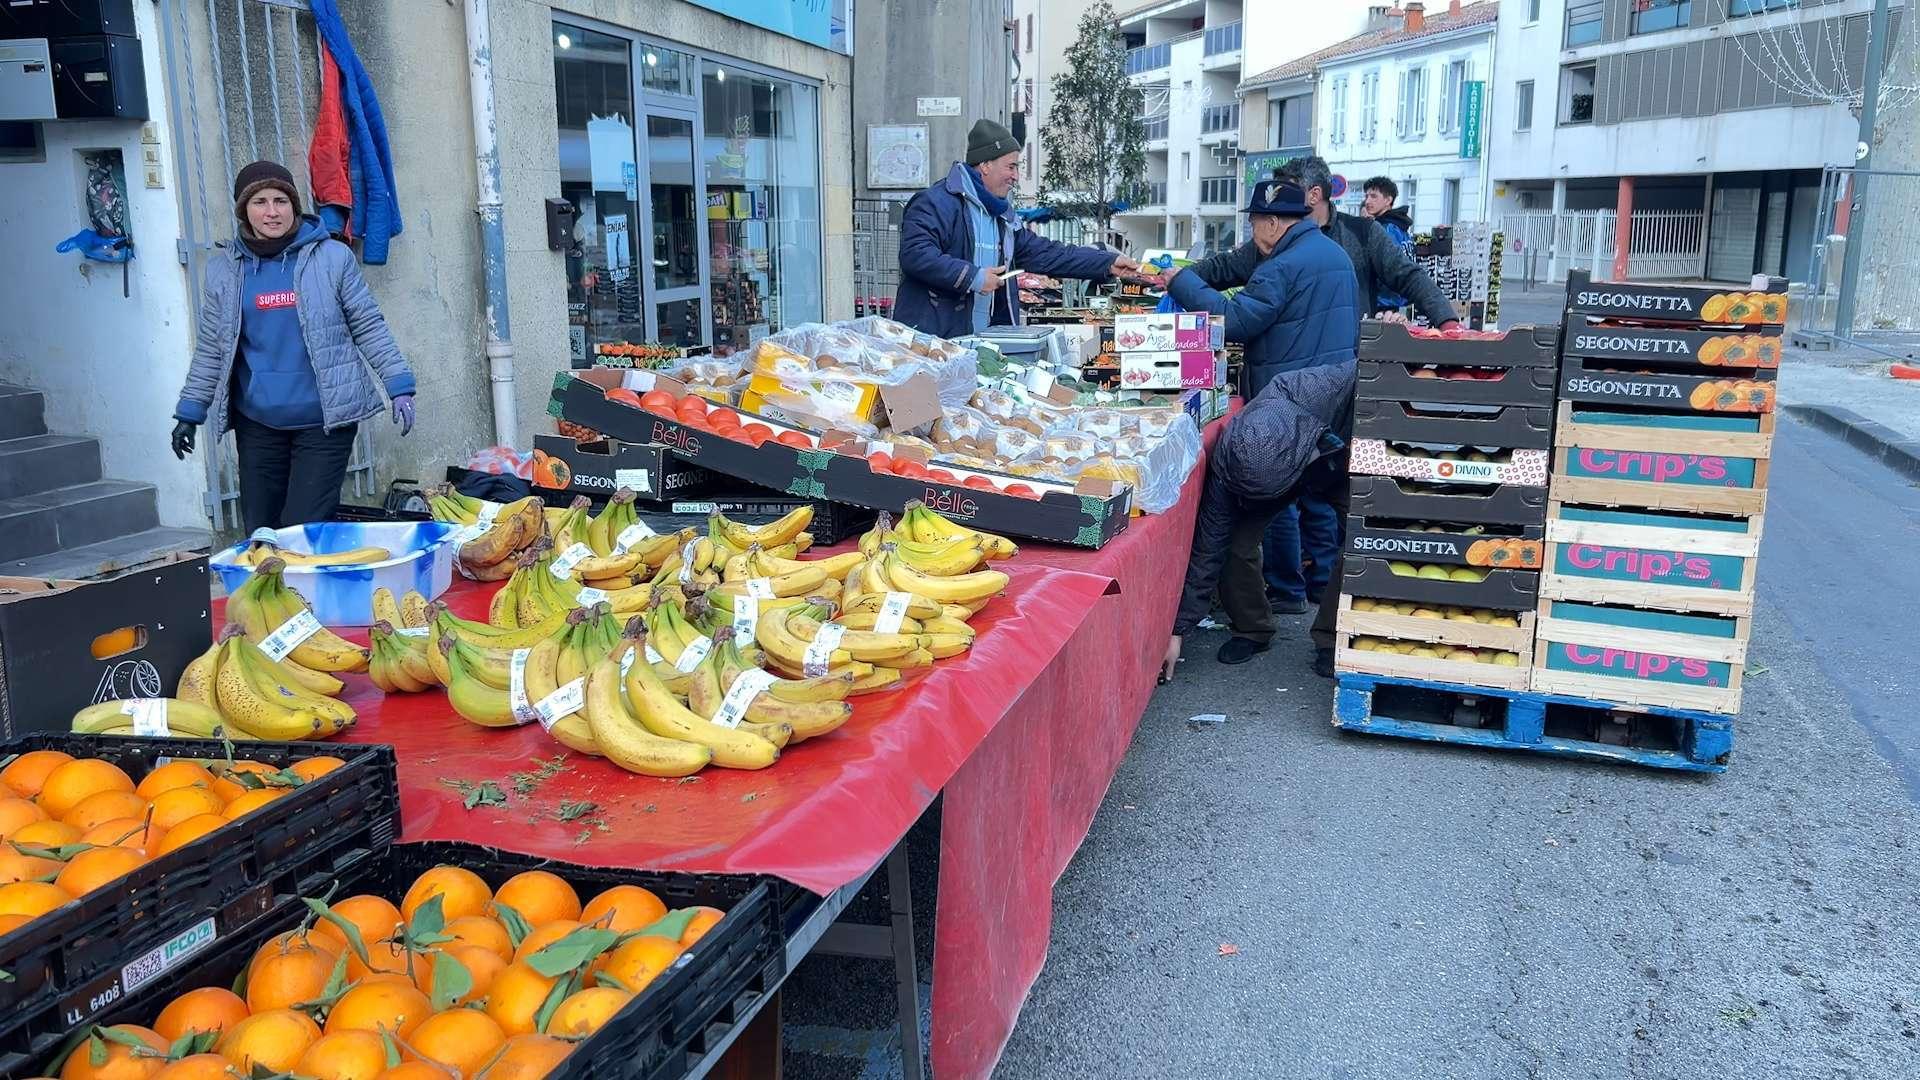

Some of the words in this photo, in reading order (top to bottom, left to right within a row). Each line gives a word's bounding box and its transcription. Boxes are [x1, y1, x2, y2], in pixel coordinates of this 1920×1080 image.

[1467, 82, 1478, 157] LABORATOIRE
[1577, 291, 1692, 311] SEGONETTA
[1147, 333, 1166, 345] Ajos
[1575, 335, 1690, 354] SEGONETTA
[1152, 370, 1173, 383] Ajos
[1567, 378, 1682, 398] SEGONETTA
[1455, 464, 1492, 476] DIVINO
[1579, 448, 1727, 483] Crip's
[924, 487, 976, 516] Bella
[1353, 537, 1459, 556] SEGONETTA
[1567, 542, 1712, 581] Crip's
[164, 931, 197, 959] IFCO
[66, 1008, 84, 1025] LL
[90, 984, 120, 1012] 6408
